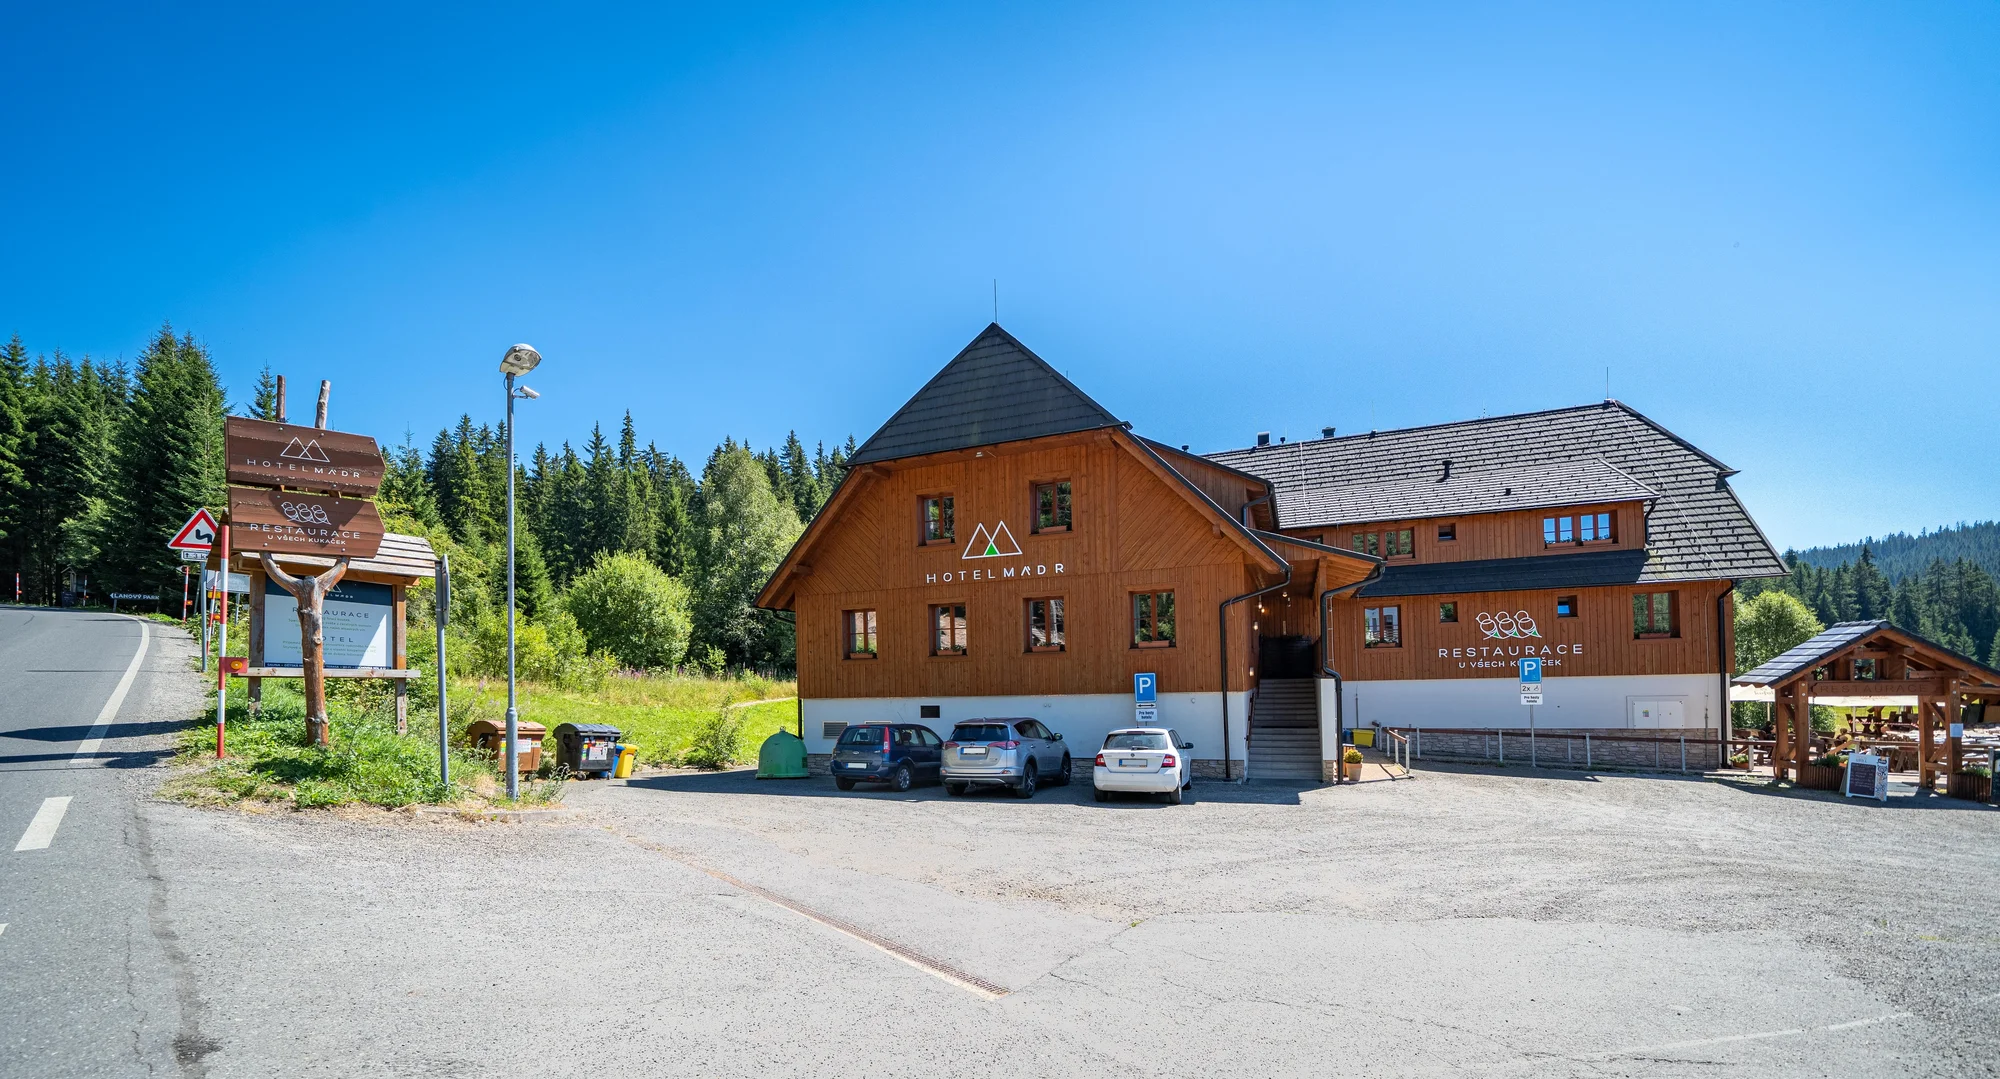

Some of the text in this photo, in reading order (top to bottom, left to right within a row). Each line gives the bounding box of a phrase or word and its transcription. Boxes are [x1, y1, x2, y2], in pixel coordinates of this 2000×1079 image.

[250, 523, 361, 539] RESTAURACE
[274, 534, 306, 543] VŠECH
[308, 537, 346, 545] KUKAČEK
[1438, 644, 1583, 658] RESTAURACE
[1458, 661, 1466, 669] U
[1470, 658, 1505, 668] VŠECH
[1524, 661, 1536, 676] P
[1139, 677, 1151, 693] P
[1820, 683, 1928, 694] RESTAURACE
